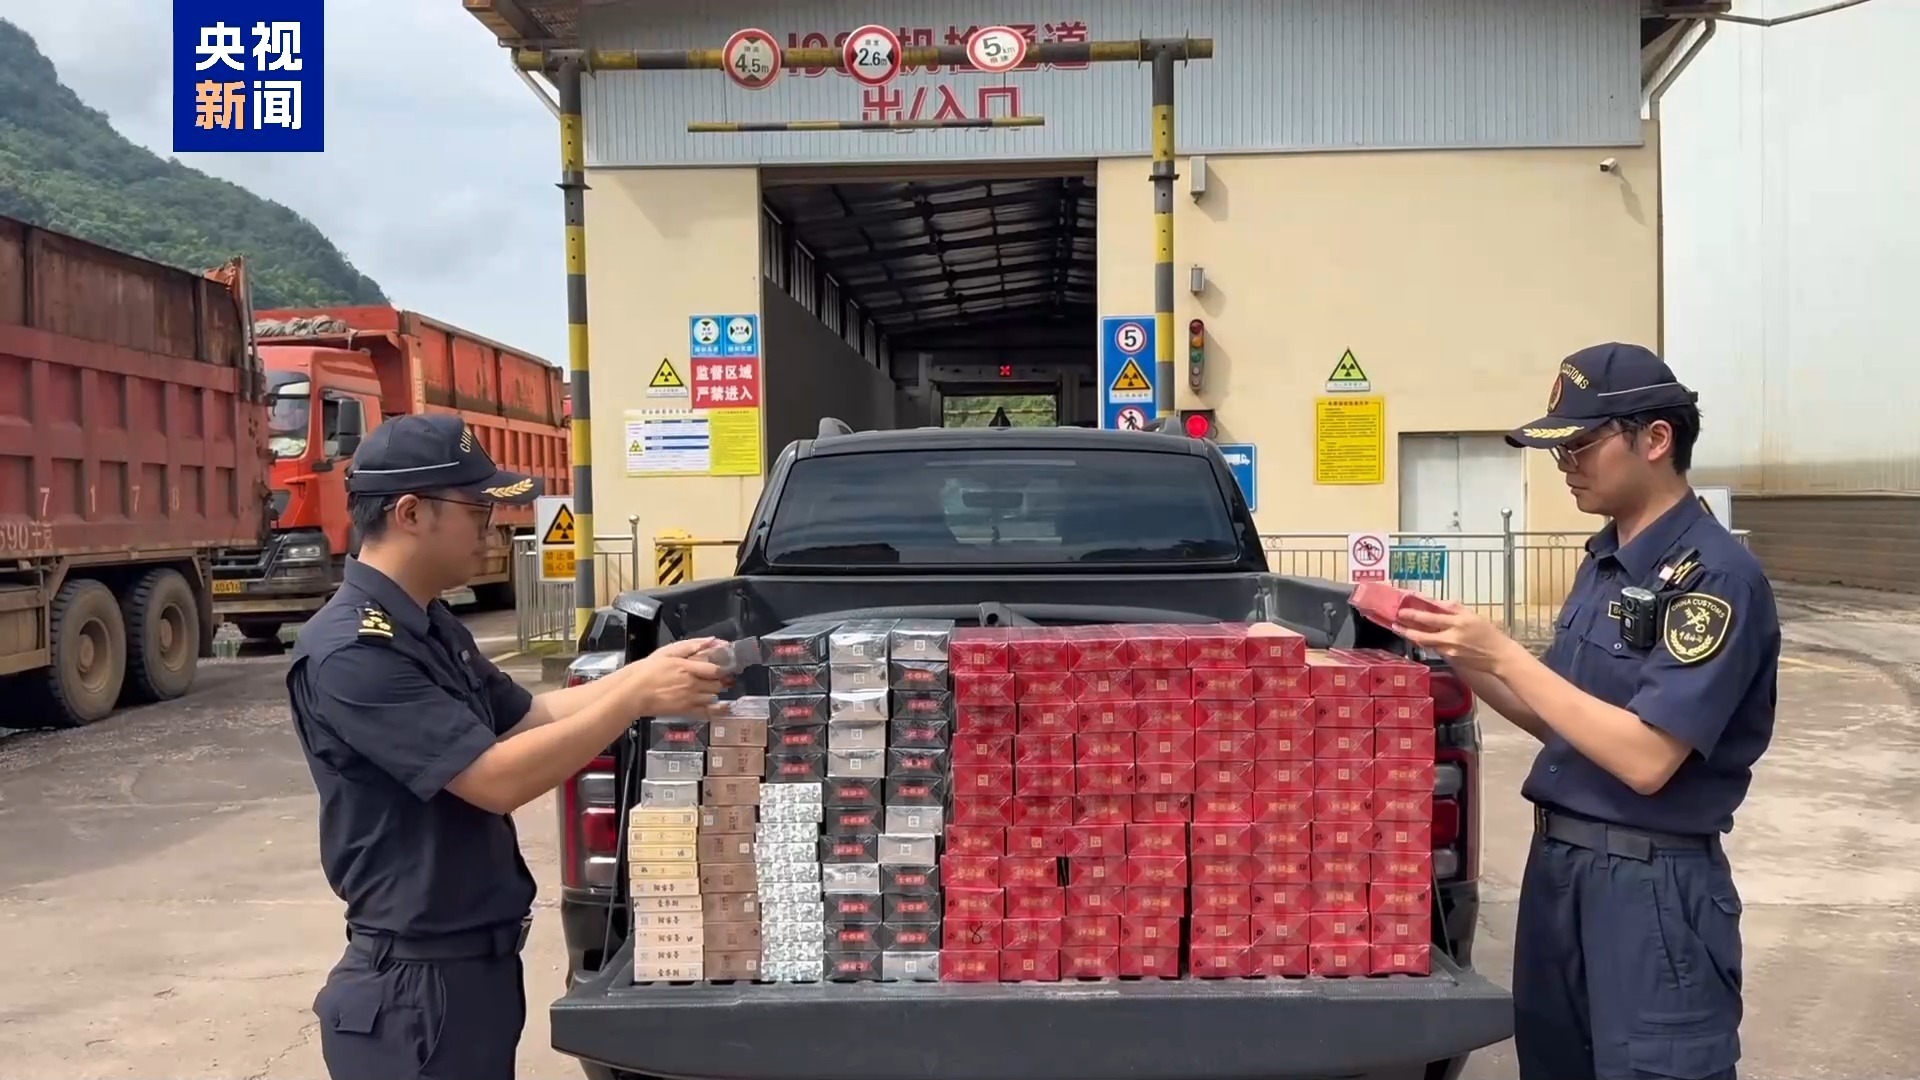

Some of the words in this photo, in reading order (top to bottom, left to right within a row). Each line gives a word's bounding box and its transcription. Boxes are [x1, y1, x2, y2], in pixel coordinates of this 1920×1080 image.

[735, 53, 770, 74] 4.5m
[858, 47, 888, 66] 2.6m
[861, 84, 1021, 133] 出/入口
[1124, 330, 1137, 347] 5
[695, 365, 753, 381] 监督区域
[1561, 363, 1590, 390] USTOMS
[695, 386, 753, 402] 严禁进入
[41, 487, 50, 517] 7
[90, 485, 97, 513] 1
[131, 485, 141, 513] 7
[1671, 598, 1692, 611] CHINA
[1692, 598, 1725, 618] CUSTOMS
